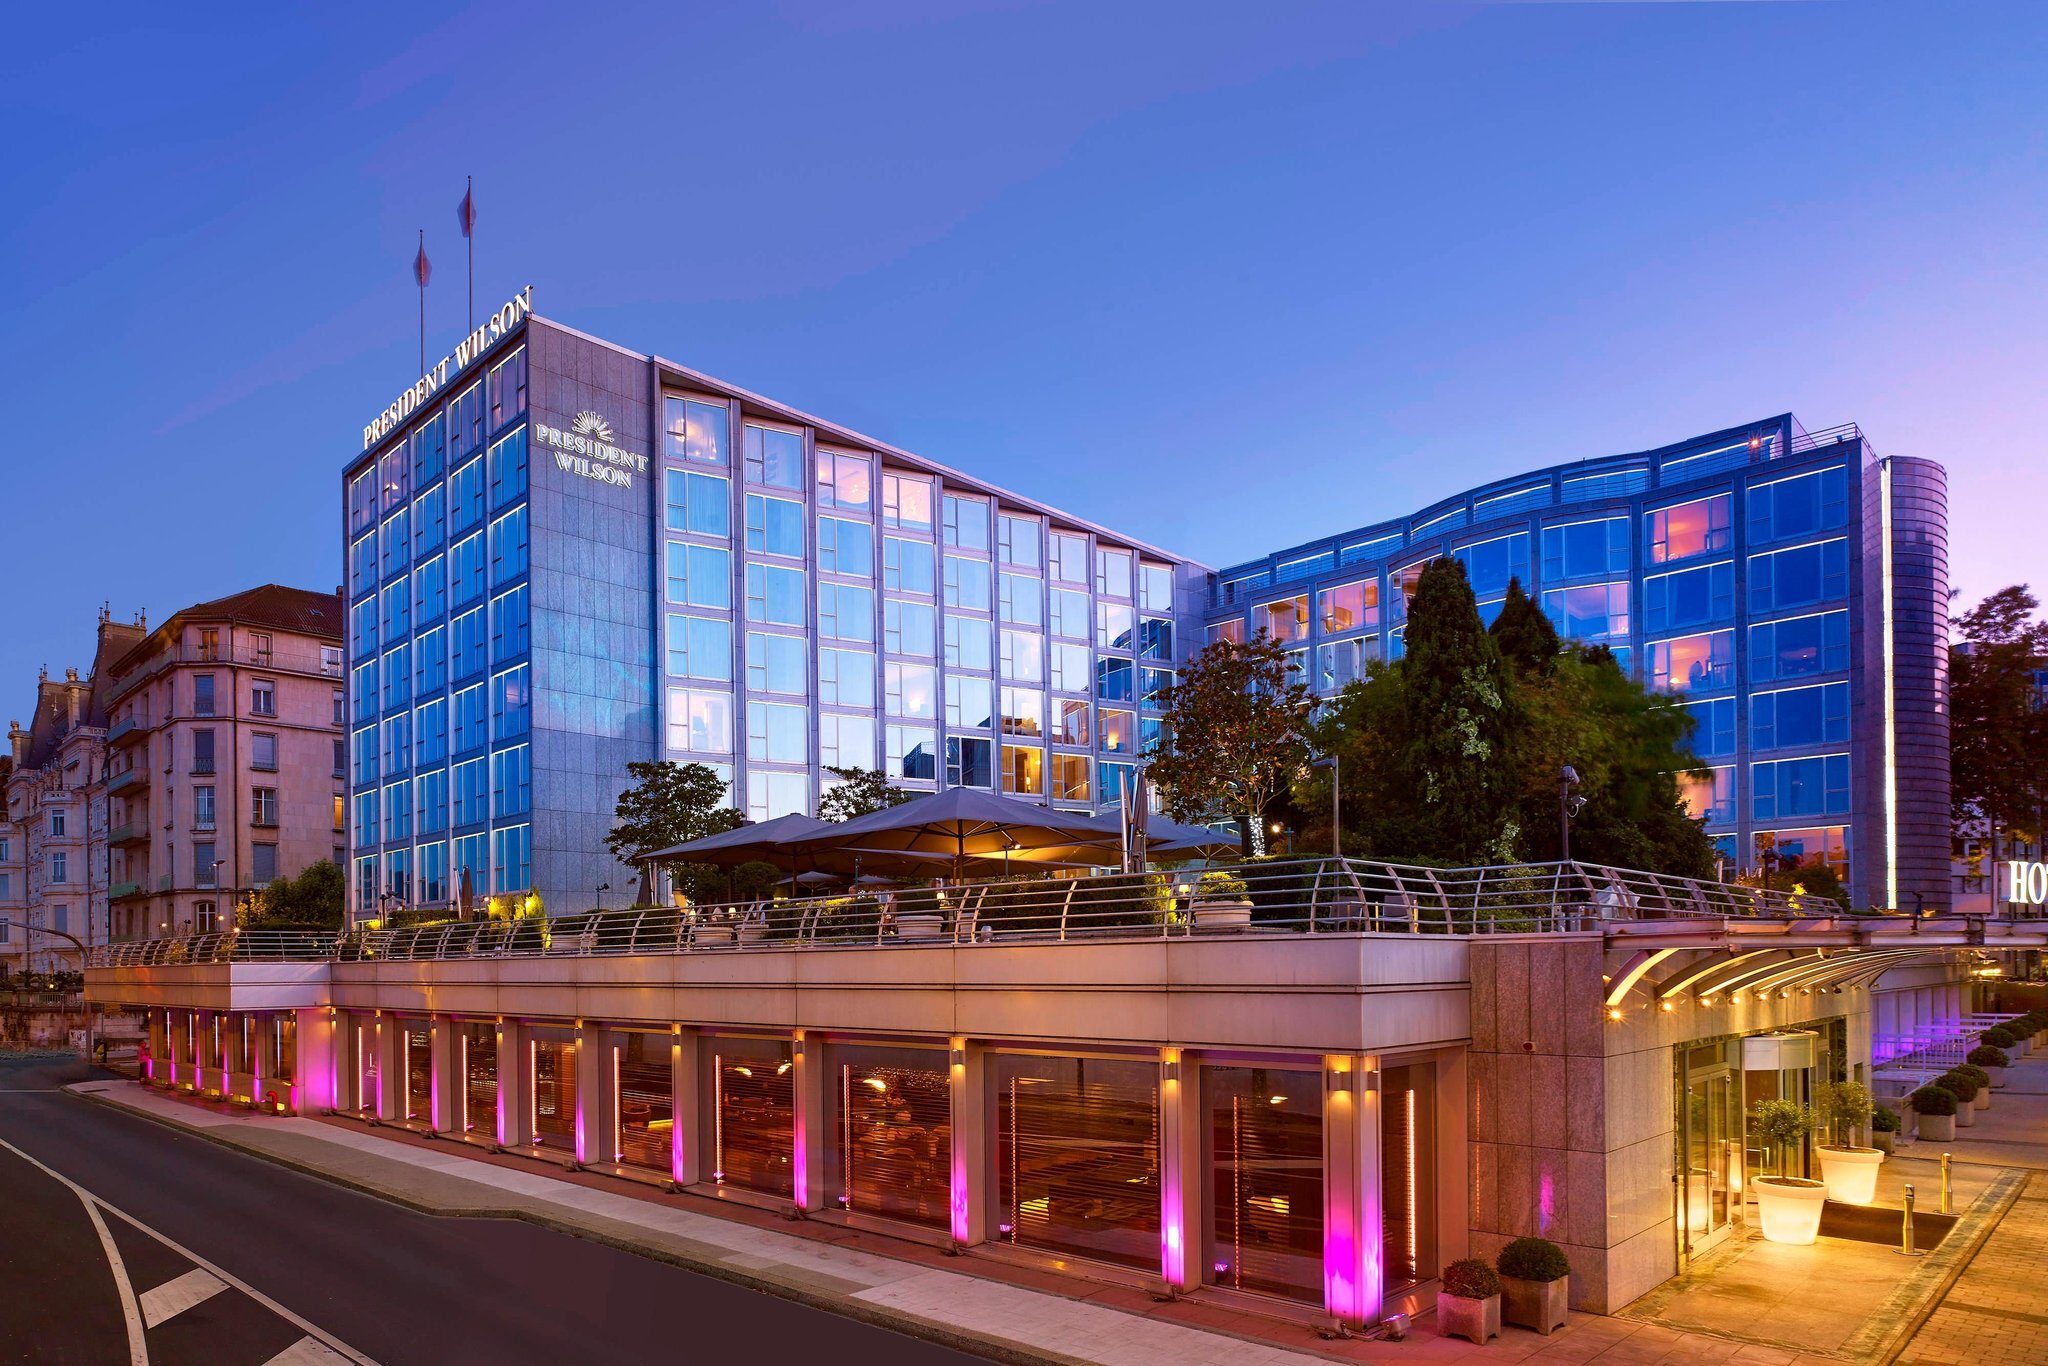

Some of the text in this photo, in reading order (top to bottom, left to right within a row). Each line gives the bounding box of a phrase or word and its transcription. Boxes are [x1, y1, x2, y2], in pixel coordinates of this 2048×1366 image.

[363, 285, 533, 450] PRESIDENT WILSON
[536, 423, 648, 472] PRESIDENT
[554, 451, 632, 488] WILSON
[2008, 861, 2048, 905] HO
